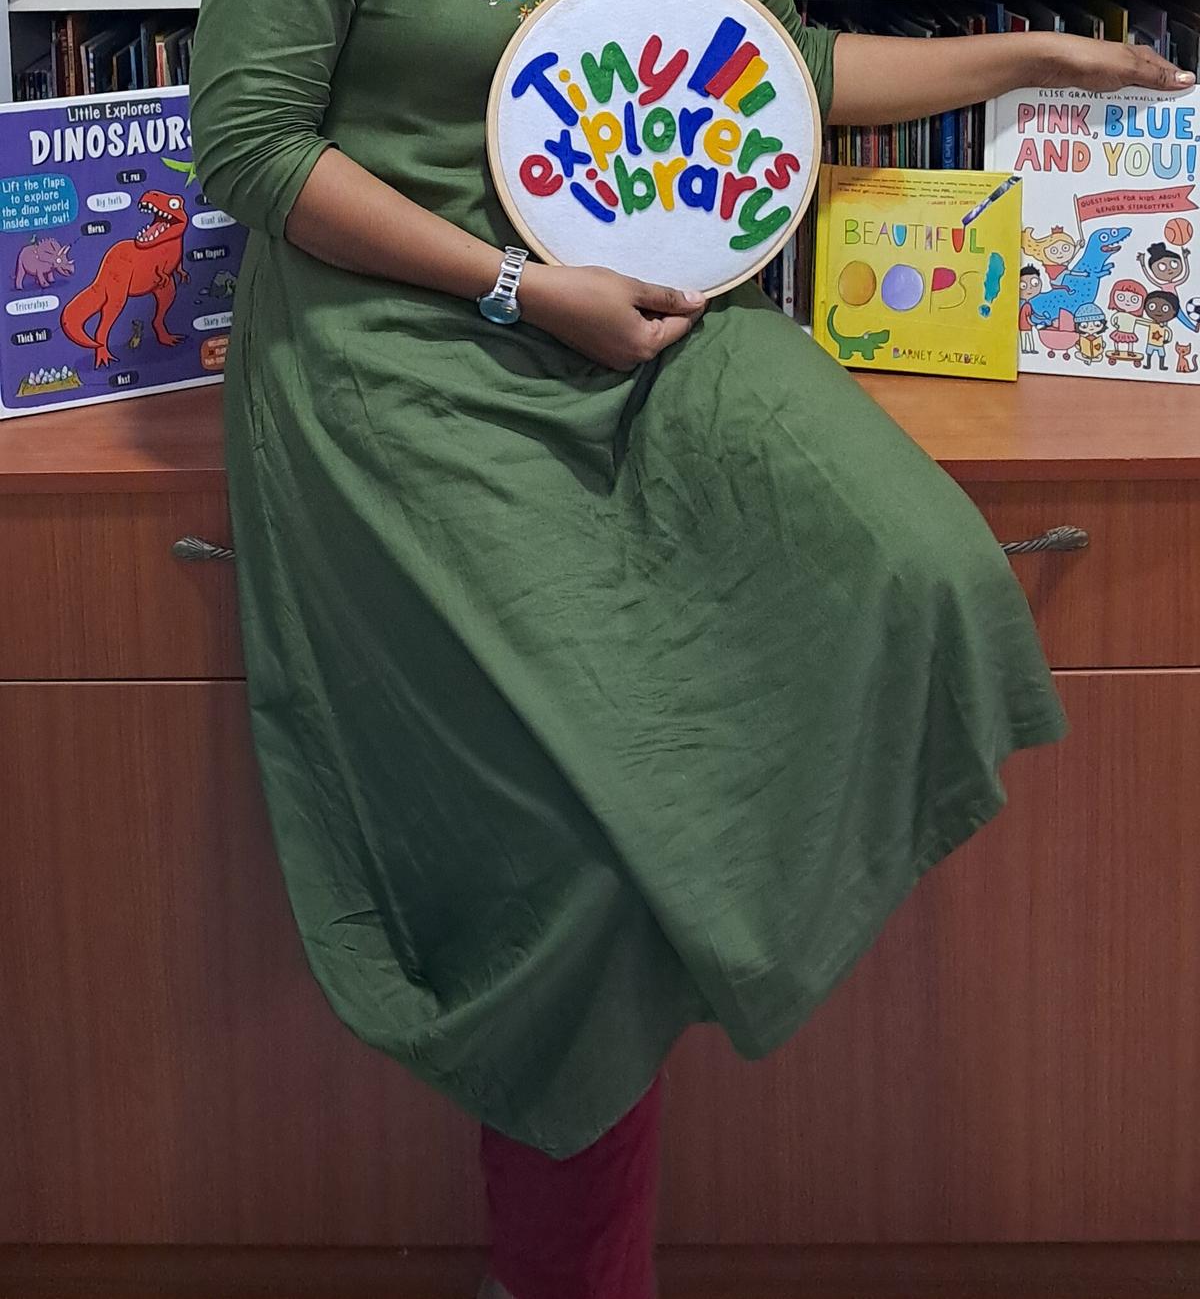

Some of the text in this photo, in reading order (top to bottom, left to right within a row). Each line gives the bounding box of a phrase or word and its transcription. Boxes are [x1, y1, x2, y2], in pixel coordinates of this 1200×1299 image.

[511, 34, 689, 127] Tiny
[1039, 90, 1103, 99] ELISE GRAVEL
[67, 102, 162, 122] Little Explorers
[1018, 103, 1200, 142] PINK, BLUE,
[519, 101, 801, 196] explorers
[1014, 138, 1197, 182] AND YOU!
[2, 177, 65, 193] Lift the flaps
[11, 190, 59, 204] to explore
[570, 154, 792, 250] library
[1080, 195, 1120, 208] QUESTIONS
[2, 200, 69, 217] the dino world
[1096, 204, 1125, 213] GENDER
[33, 216, 48, 227] and
[52, 213, 70, 225] out!
[844, 219, 985, 254] BEAUTIFUL
[838, 252, 1006, 318] OOPS!
[893, 347, 987, 366] BARNEY SALTZBERG
